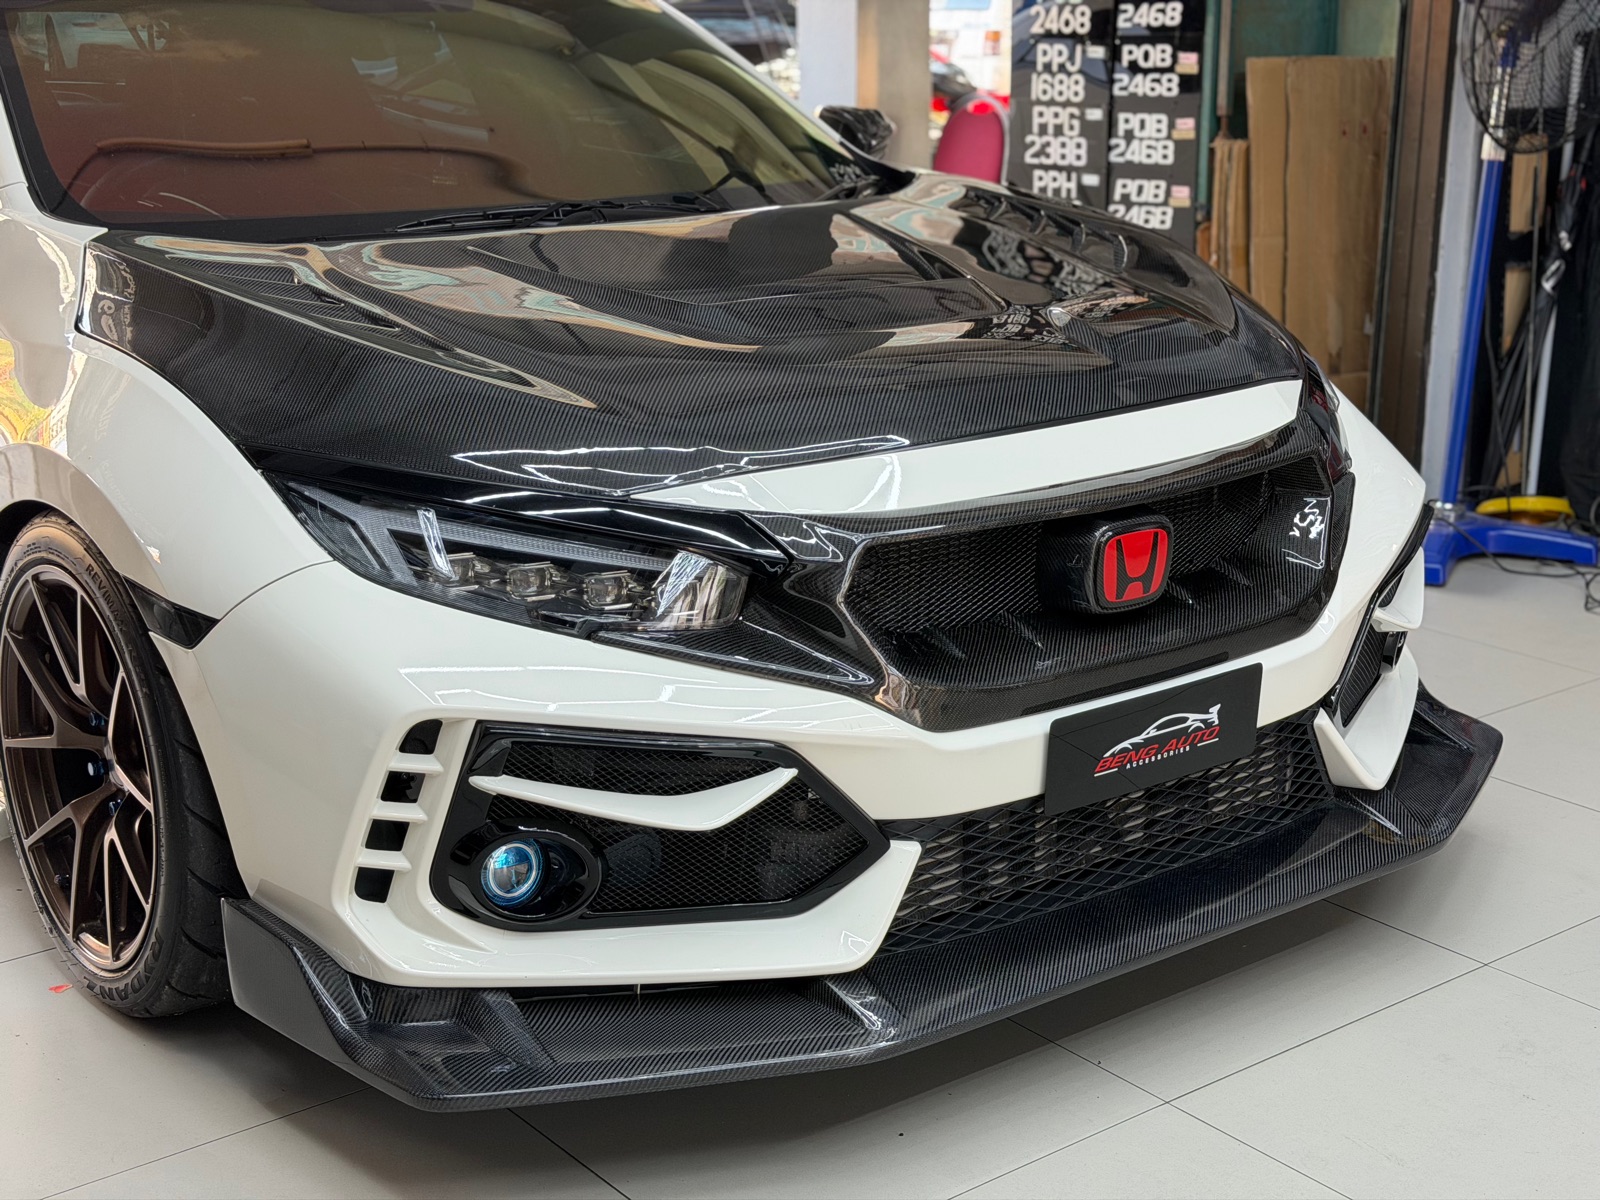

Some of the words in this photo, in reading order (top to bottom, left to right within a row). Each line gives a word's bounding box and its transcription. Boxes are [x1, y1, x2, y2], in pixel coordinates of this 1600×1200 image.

[1029, 5, 1091, 35] 2468
[1118, 1, 1183, 28] 2468
[1036, 43, 1083, 73] PPJ
[1121, 44, 1173, 68] PQB
[1030, 73, 1085, 103] 1688
[1112, 73, 1180, 97] 2468
[1032, 105, 1080, 137] PPG
[1024, 134, 1087, 167] 2388
[1108, 137, 1175, 165] 2468
[1032, 169, 1078, 199] PPH
[1094, 744, 1159, 773] BENG
[1161, 726, 1220, 754] AUTO
[1126, 746, 1190, 769] ACCESSORIES
